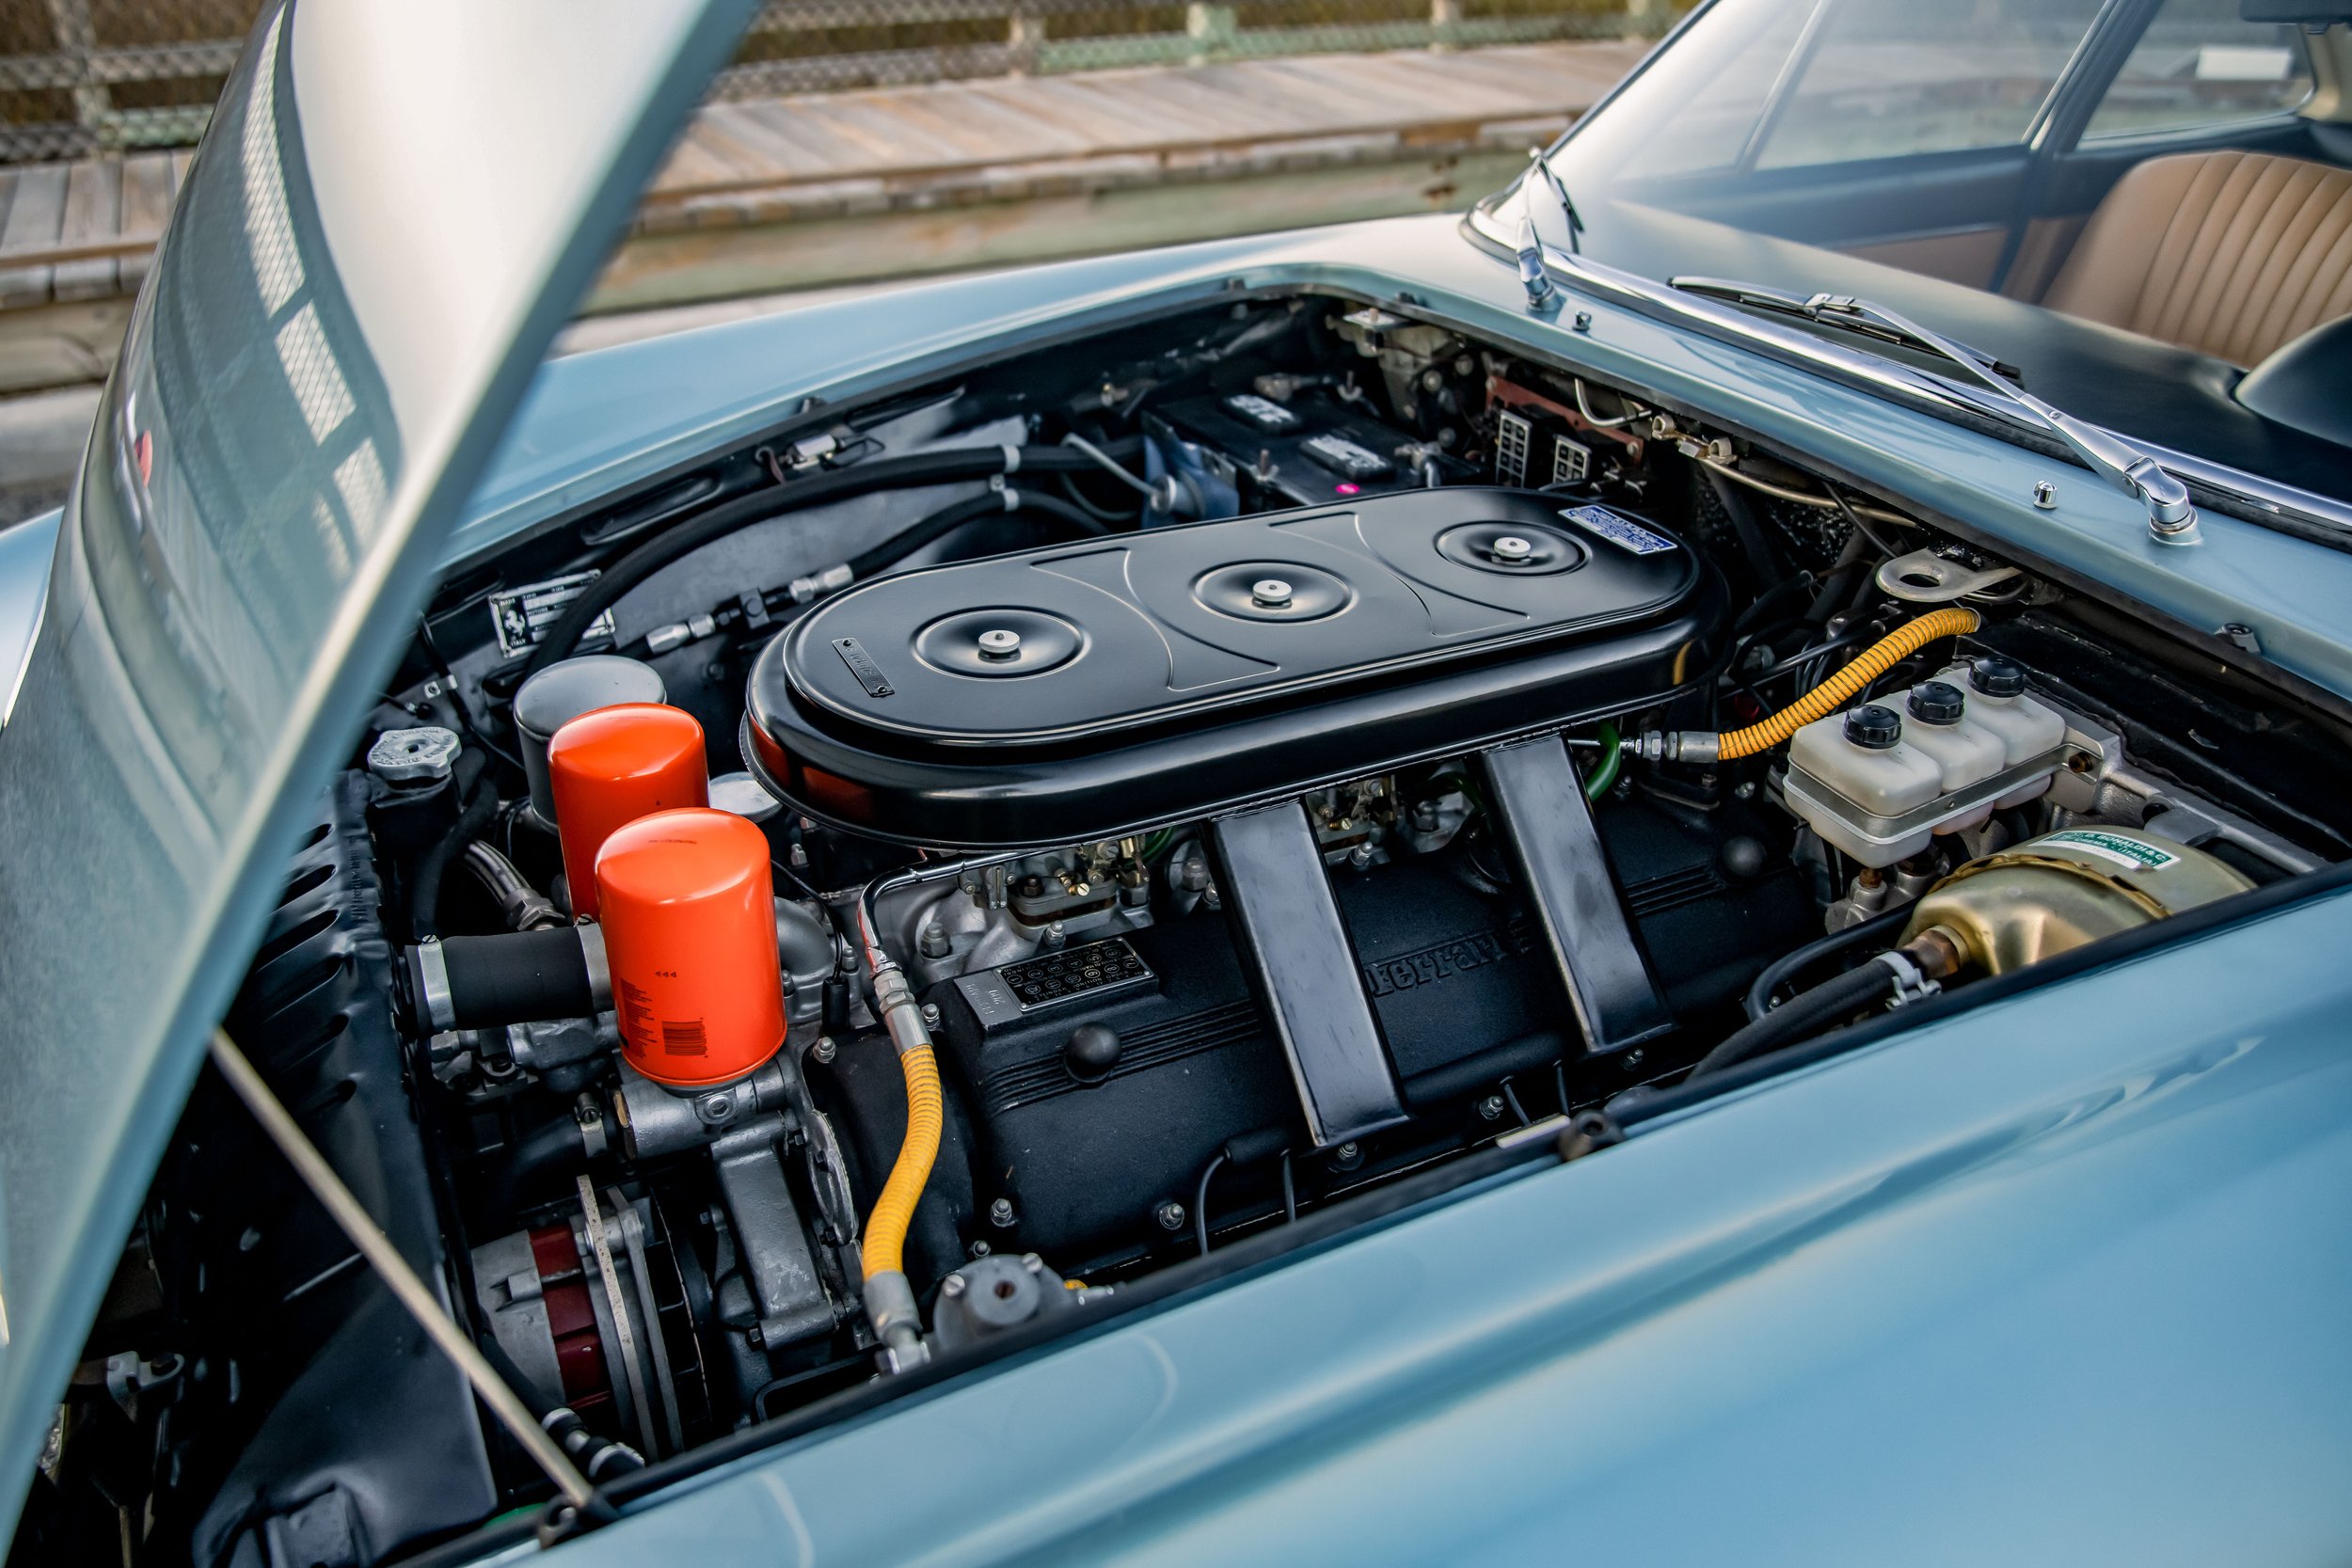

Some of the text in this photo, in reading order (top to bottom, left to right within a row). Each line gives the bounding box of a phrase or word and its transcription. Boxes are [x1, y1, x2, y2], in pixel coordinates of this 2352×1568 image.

[510, 639, 526, 647] ITALY
[2097, 834, 2147, 851] BONALDI
[1073, 977, 1102, 989] IGNITION
